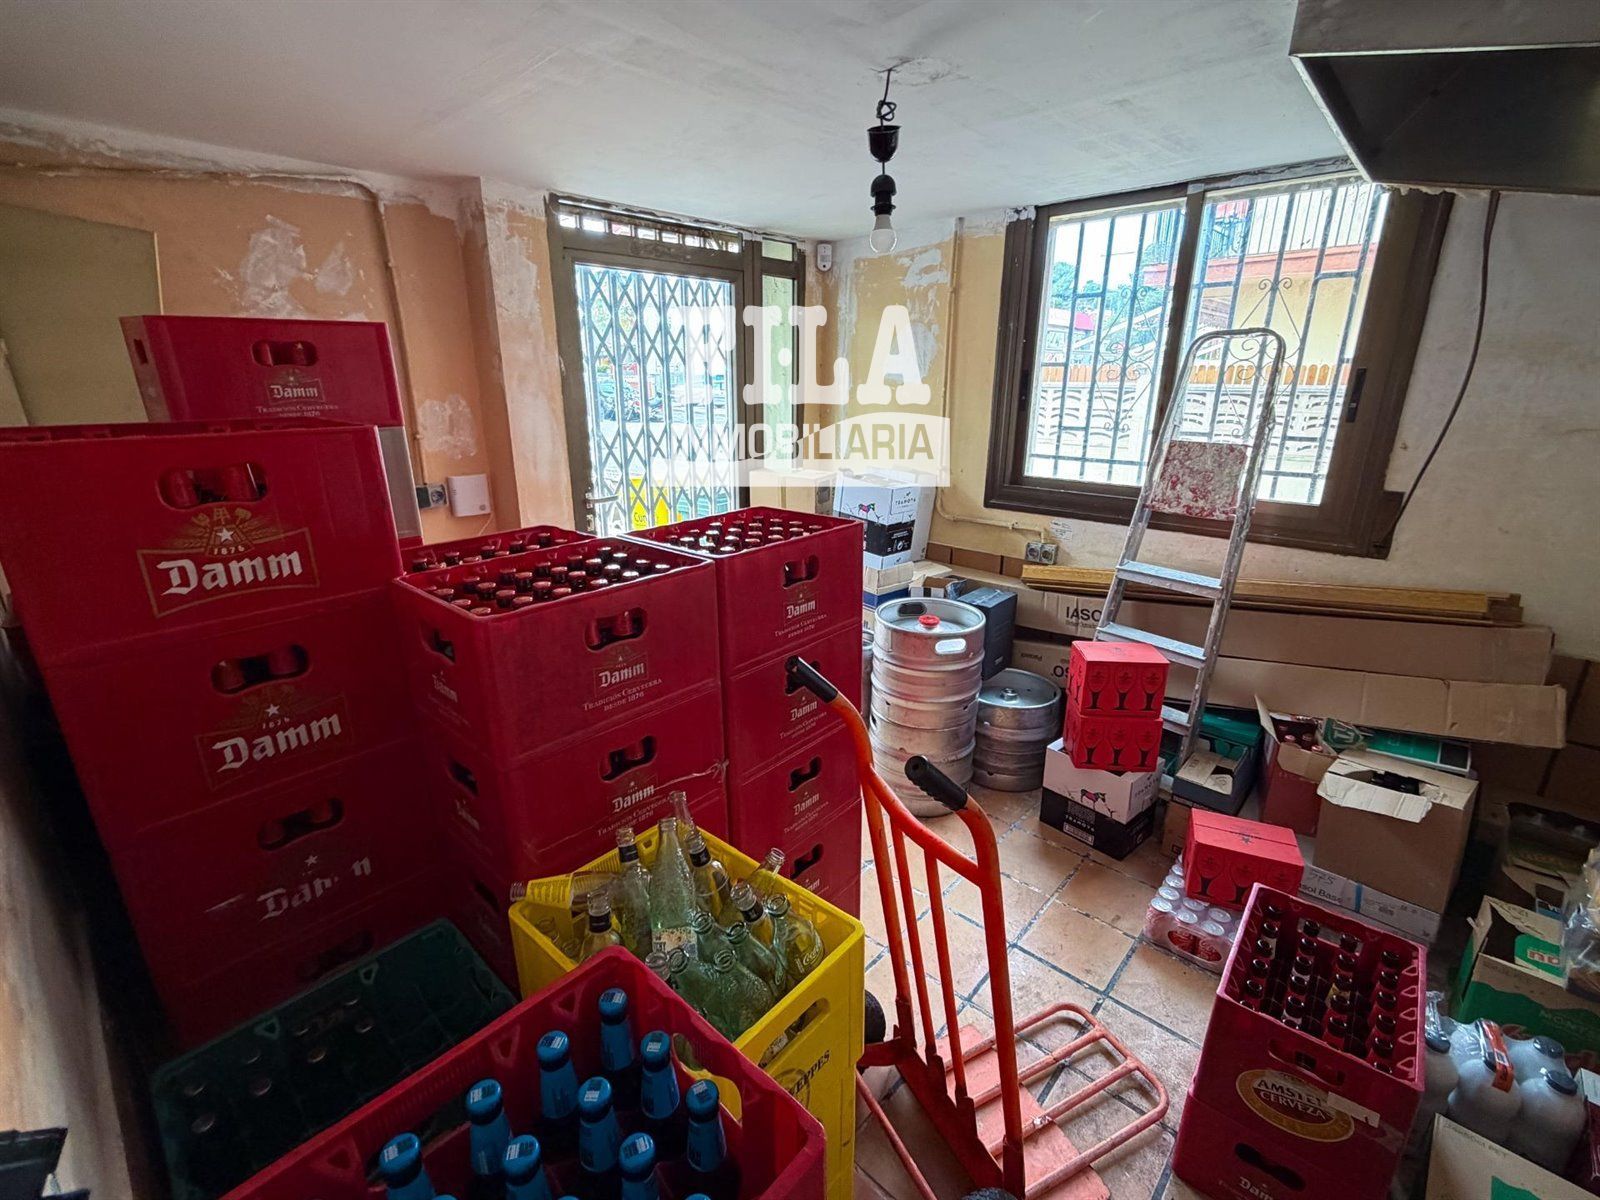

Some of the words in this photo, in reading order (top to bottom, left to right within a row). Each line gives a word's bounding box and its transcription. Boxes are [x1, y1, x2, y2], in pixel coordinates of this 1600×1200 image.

[270, 384, 319, 399] Damm
[213, 544, 246, 556] 1876
[156, 550, 303, 596] Damm
[787, 600, 816, 619] Damm
[598, 662, 645, 689] Damm
[789, 701, 818, 722] Damm
[211, 713, 342, 773] Damm
[611, 784, 656, 815] Damm
[793, 792, 821, 816] Damm
[1260, 1090, 1328, 1121] CERVEZA
